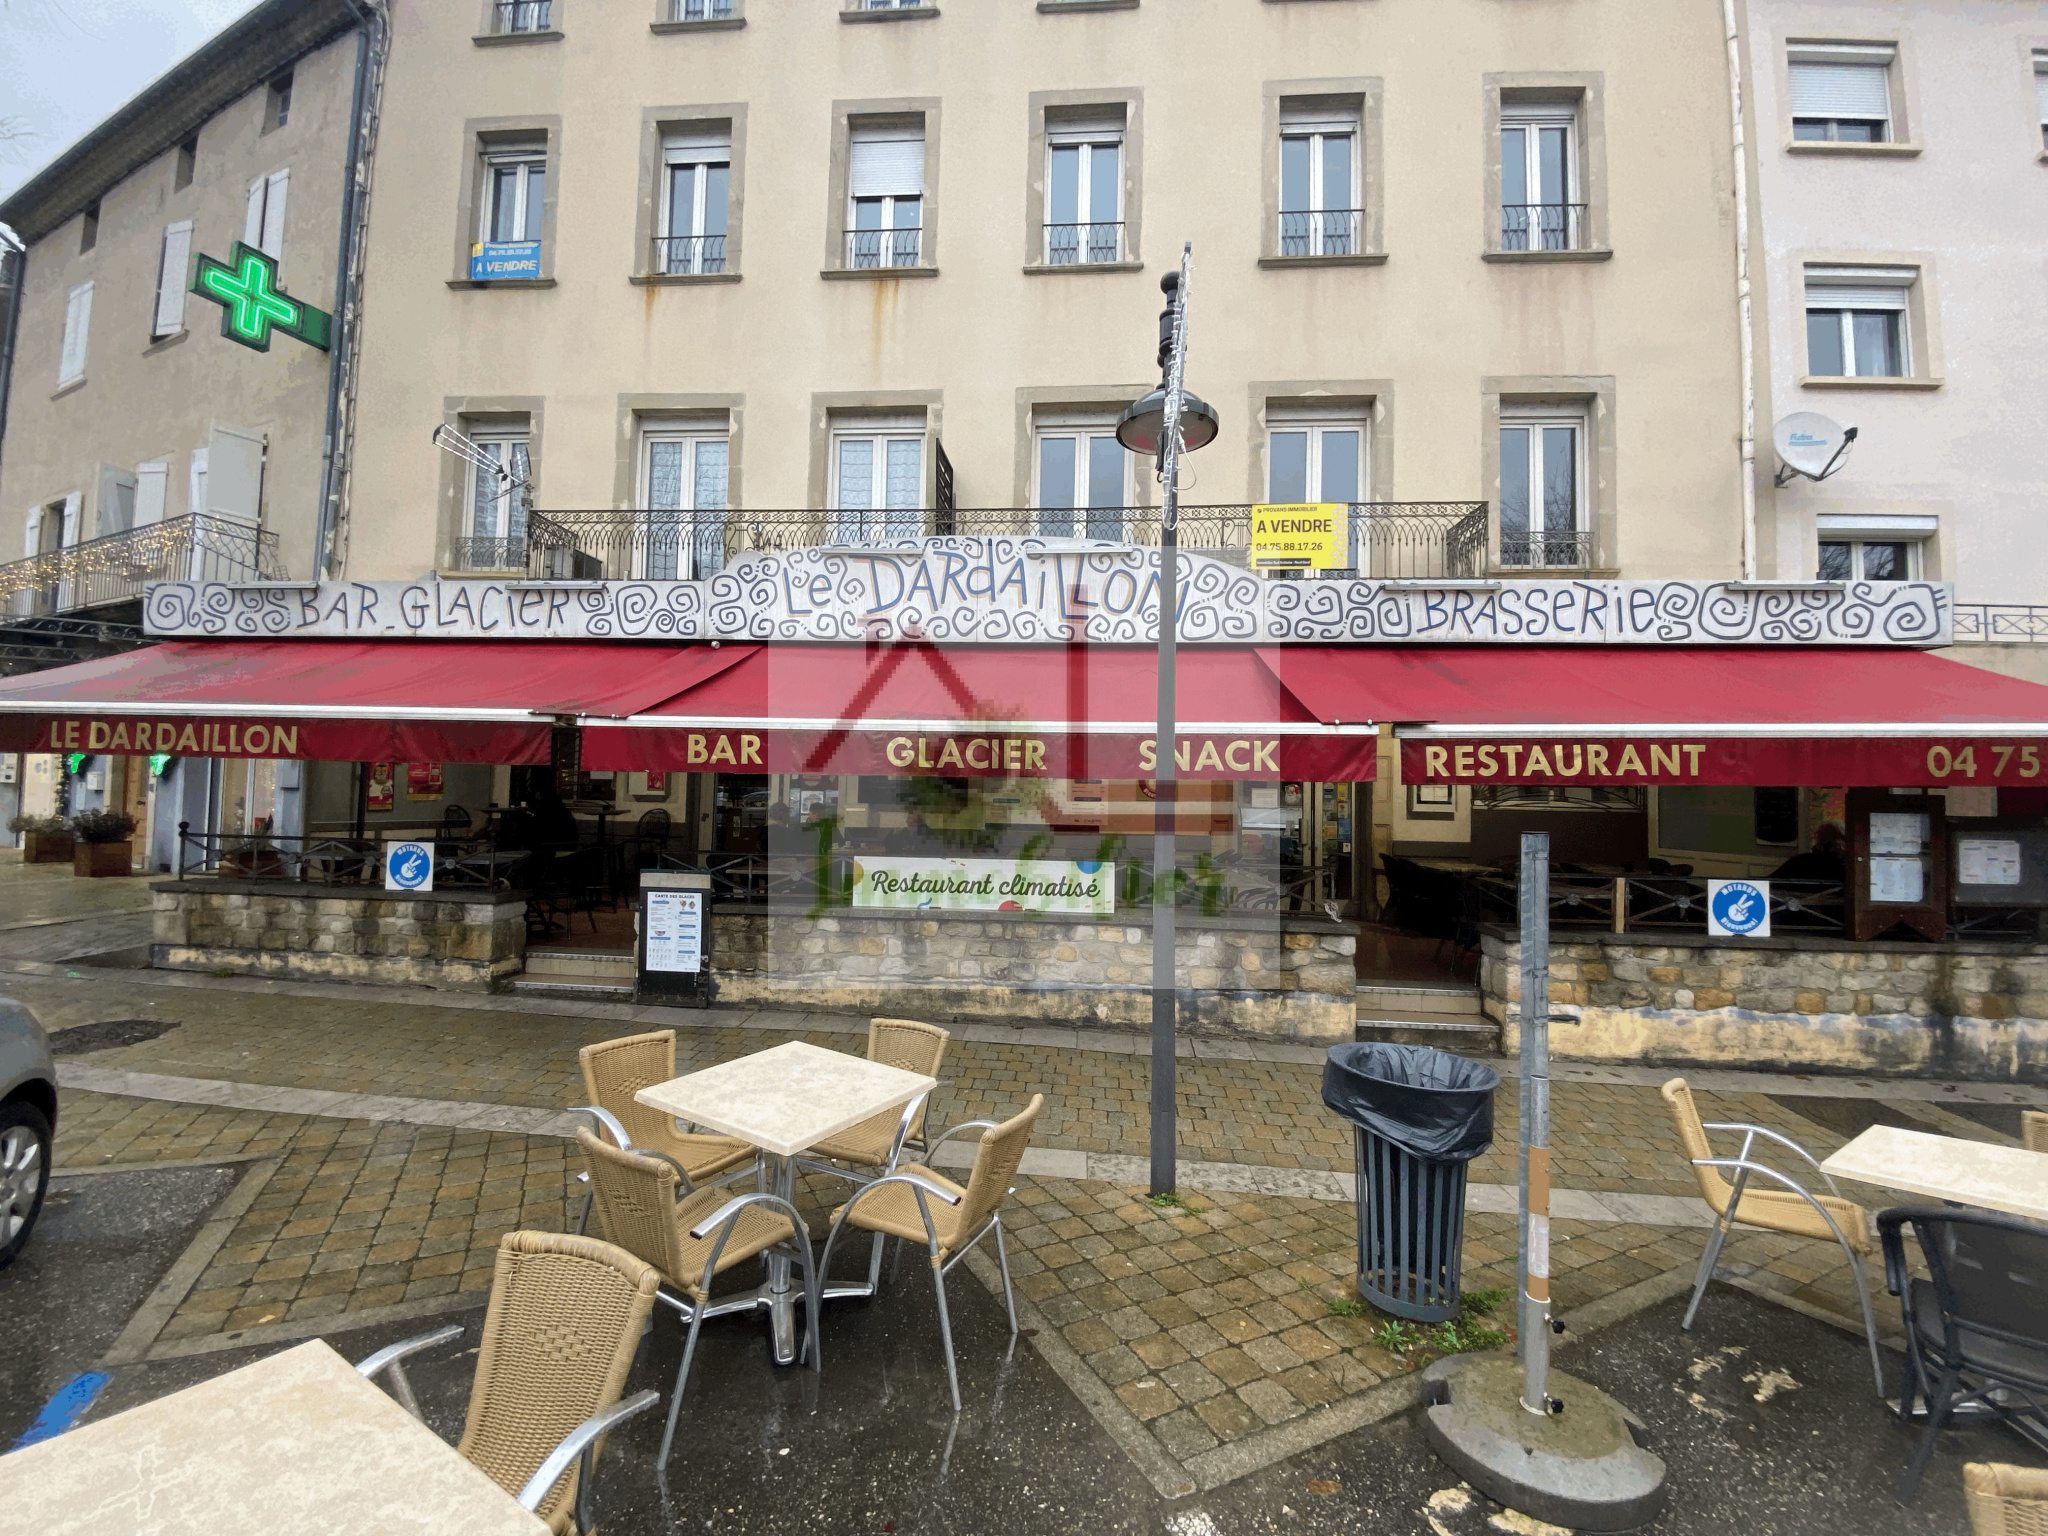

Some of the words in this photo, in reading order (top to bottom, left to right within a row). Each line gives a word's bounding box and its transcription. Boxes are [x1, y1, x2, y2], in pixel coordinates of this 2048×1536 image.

[475, 262, 483, 272] A
[487, 260, 537, 272] VENDRE
[1257, 520, 1267, 533] A
[1271, 519, 1332, 533] VENDRE
[1256, 542, 1323, 551] 04.75.88.17.26
[781, 566, 833, 615] Le
[296, 582, 379, 630] BAR
[51, 721, 80, 749] LE
[89, 722, 298, 754] DARDAILLON
[687, 734, 763, 765] BAR
[886, 737, 1047, 771] GLACIER
[1139, 740, 1280, 773] SNACK
[1426, 744, 1706, 777] RESTAURANT
[1926, 746, 1977, 778] 04
[1991, 746, 2039, 777] 75
[397, 845, 424, 856] MOTARDS
[871, 869, 995, 896] Restaurant
[998, 875, 1101, 898] climatisé
[1721, 883, 1757, 896] MOTARDS
